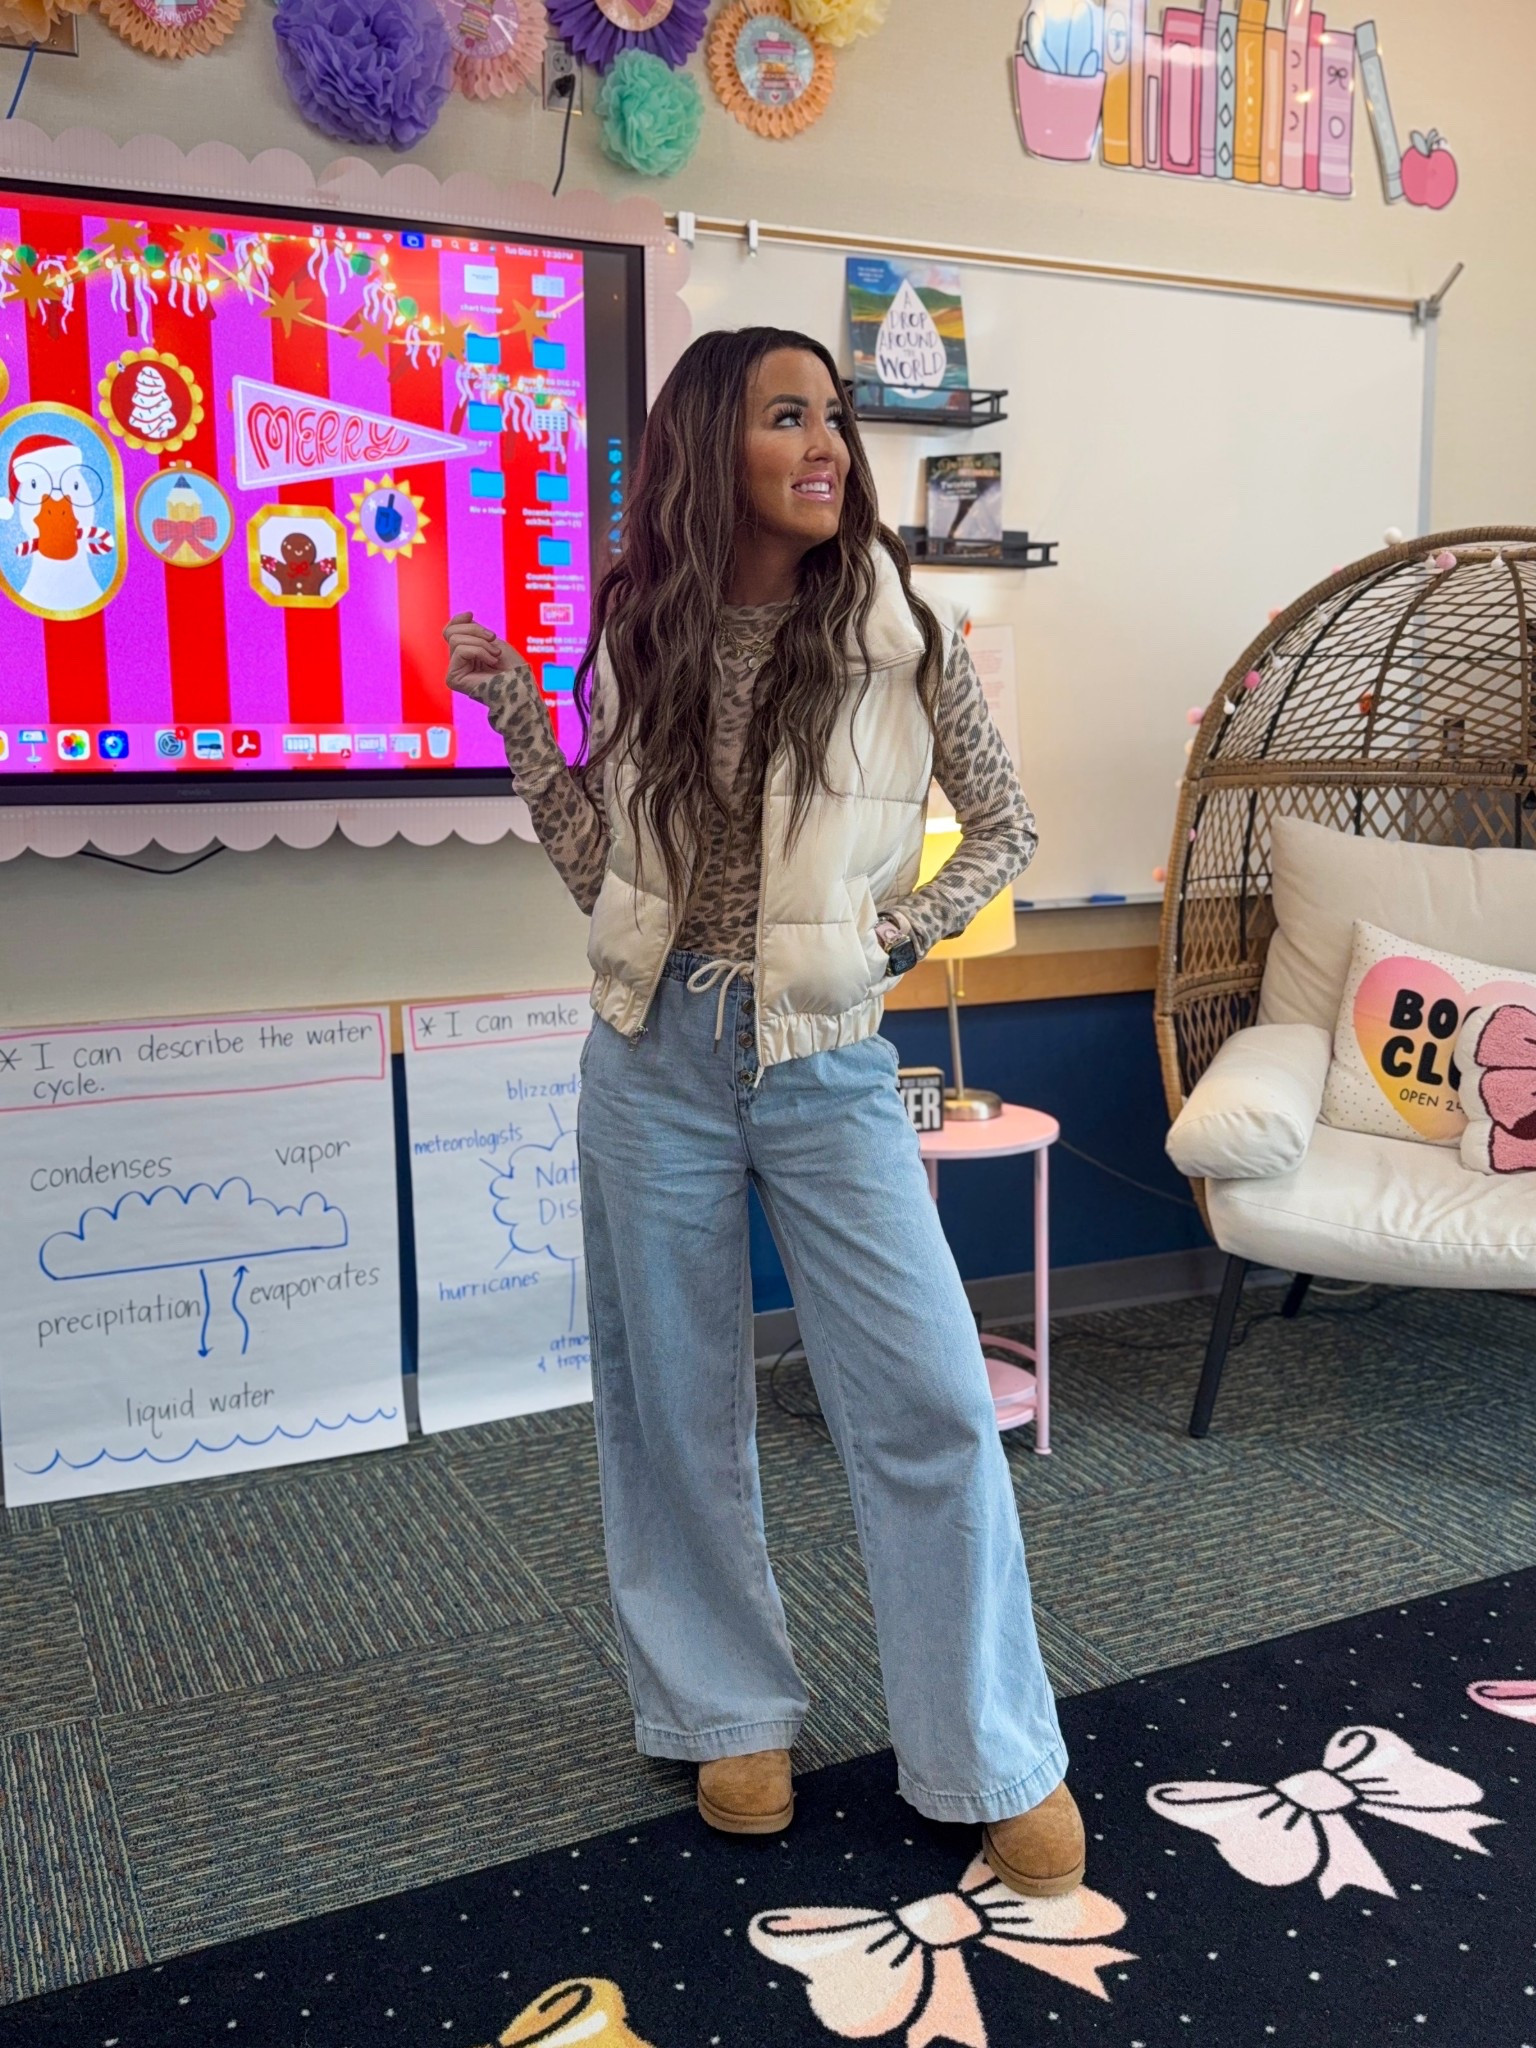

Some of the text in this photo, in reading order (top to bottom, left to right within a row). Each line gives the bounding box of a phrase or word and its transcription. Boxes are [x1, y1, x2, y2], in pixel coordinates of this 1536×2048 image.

[533, 248, 539, 257] 2
[903, 290, 912, 308] A
[890, 311, 928, 329] DROP
[879, 330, 938, 350] AROUND
[880, 352, 944, 381] WORLD
[247, 402, 410, 470] MERRY
[444, 1003, 579, 1038] I can make
[31, 1020, 373, 1071] I can describe the water
[33, 1072, 105, 1104] cycle.
[1400, 1088, 1439, 1107] OPEN
[414, 1122, 524, 1155] meteorologists
[275, 1139, 350, 1173] vapor
[250, 1262, 381, 1310] evaporates
[439, 1271, 540, 1302] hurricanes
[37, 1294, 201, 1348] precipitation
[126, 1382, 276, 1440] liquid water
